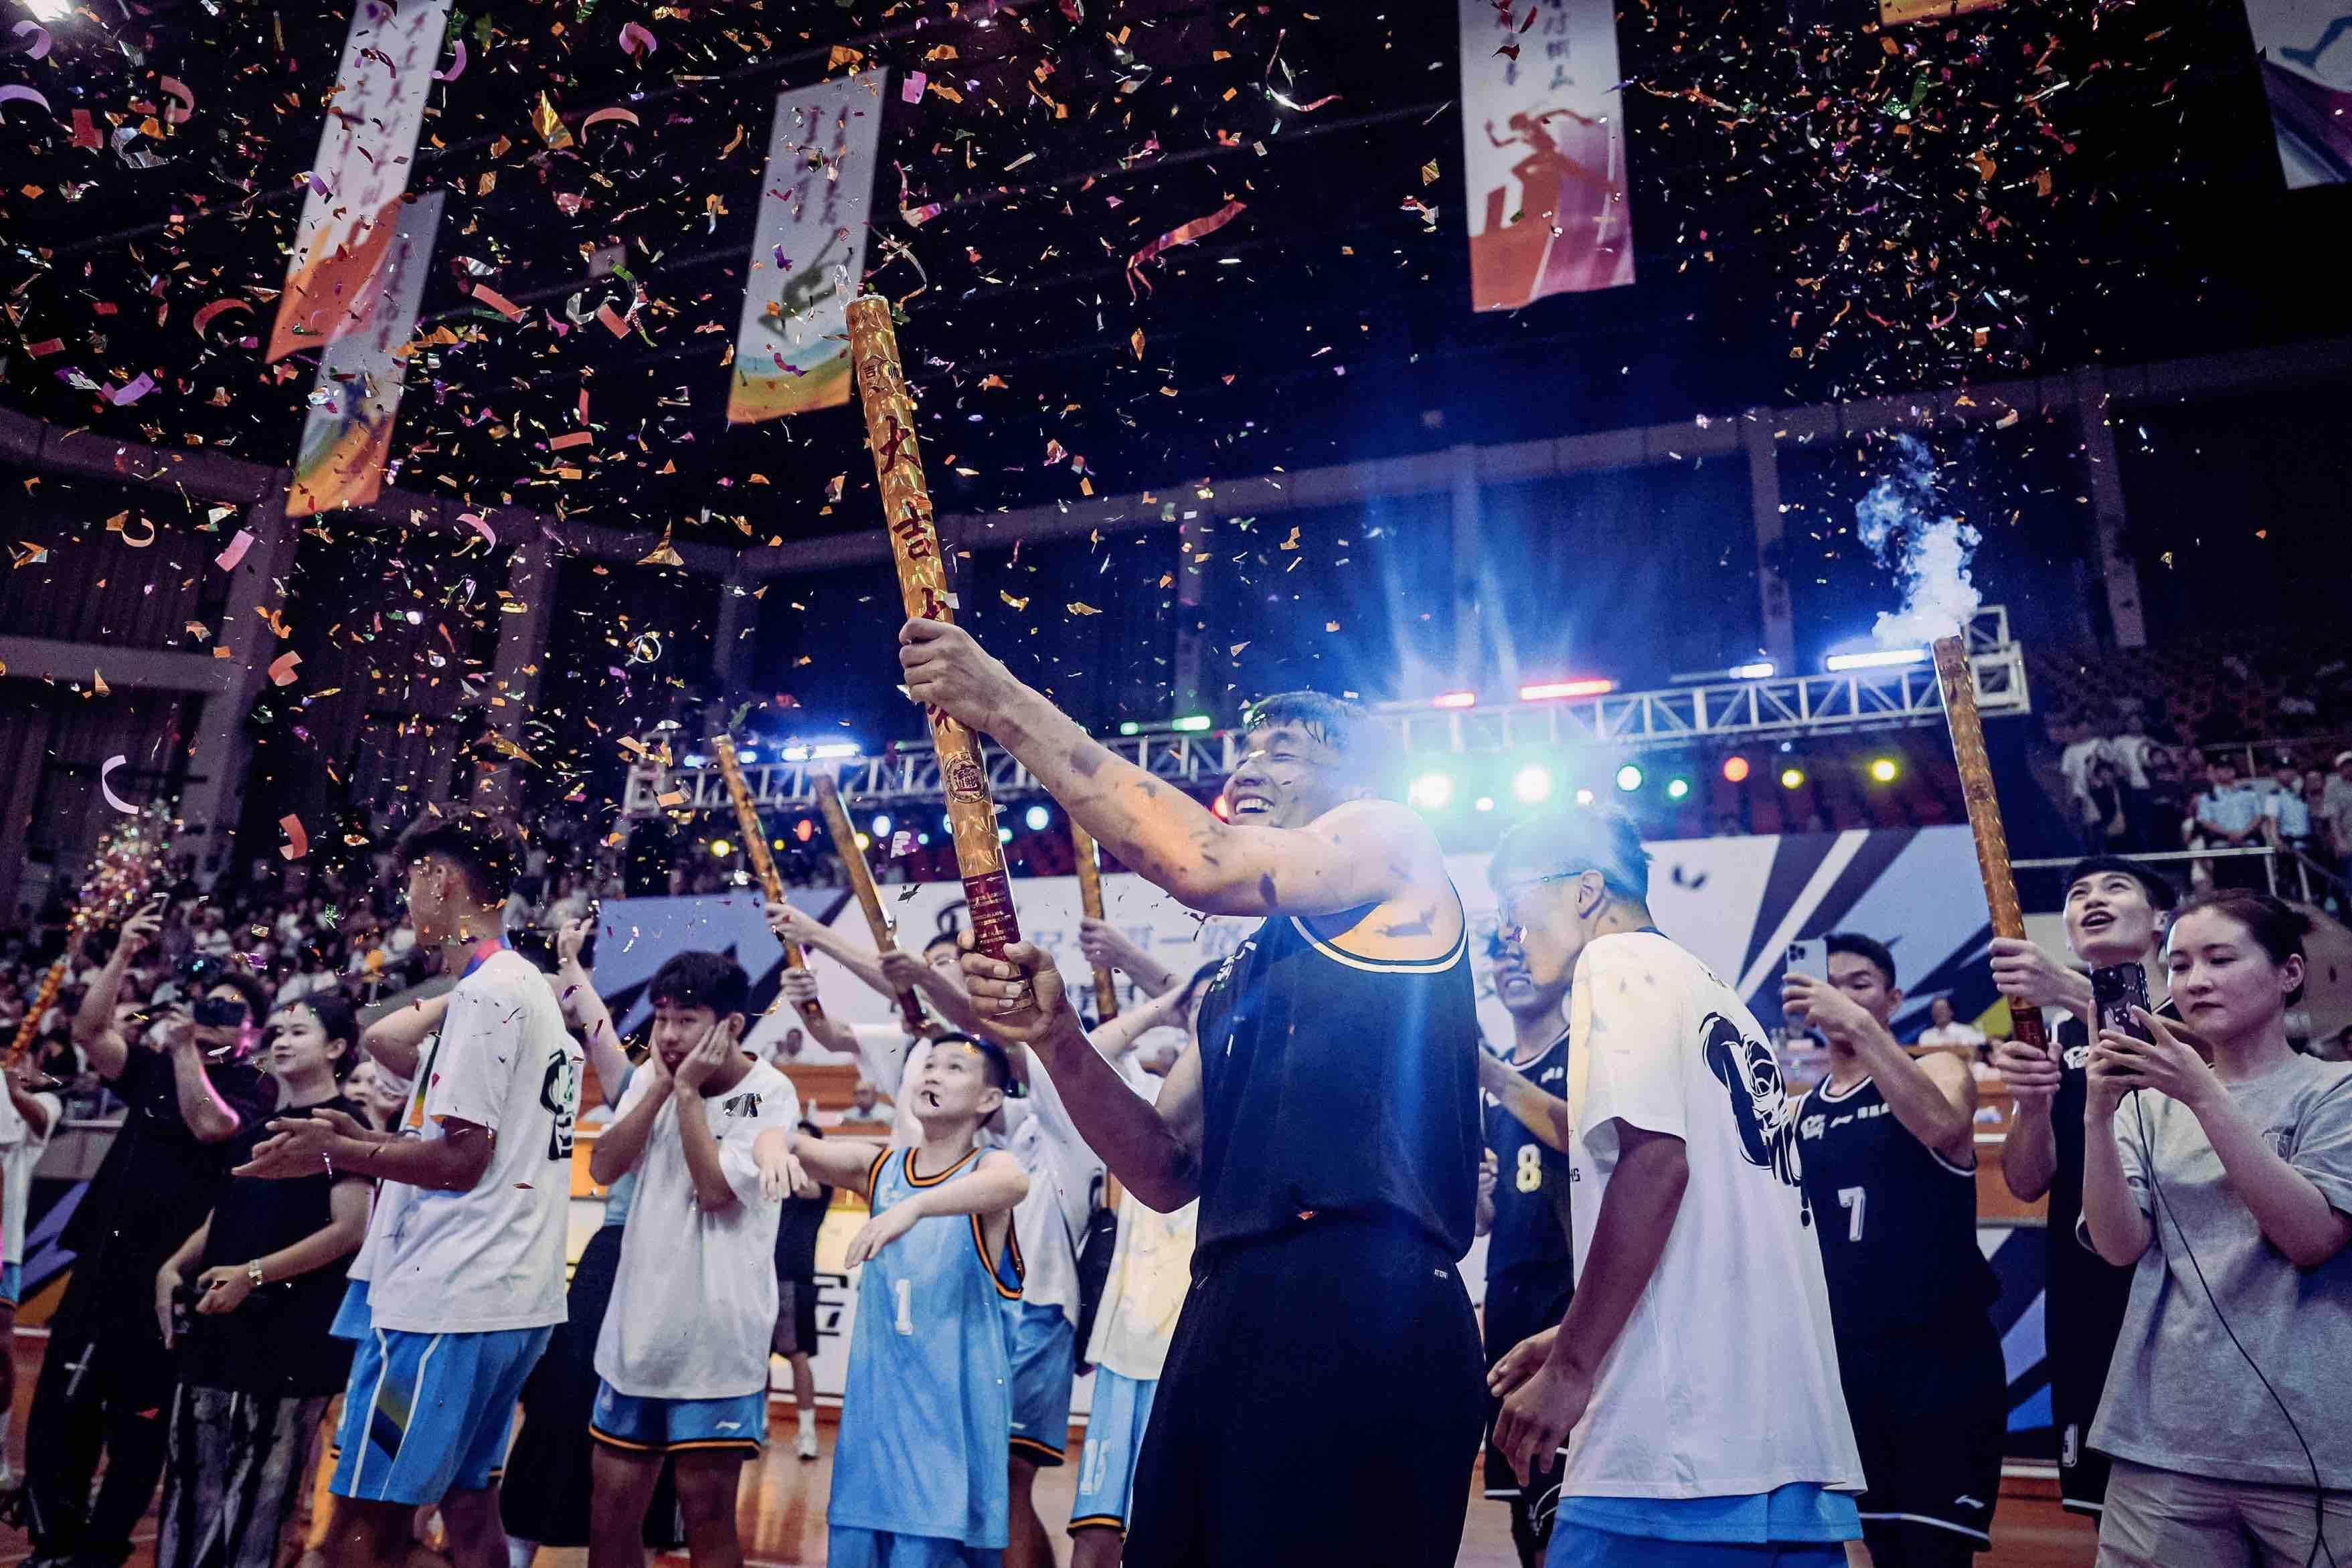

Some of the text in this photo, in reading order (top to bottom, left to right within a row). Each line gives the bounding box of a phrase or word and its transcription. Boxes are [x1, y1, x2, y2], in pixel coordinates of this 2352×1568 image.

[1517, 1144, 1542, 1193] 8
[1838, 1187, 1866, 1241] 7
[895, 1279, 913, 1335] 1
